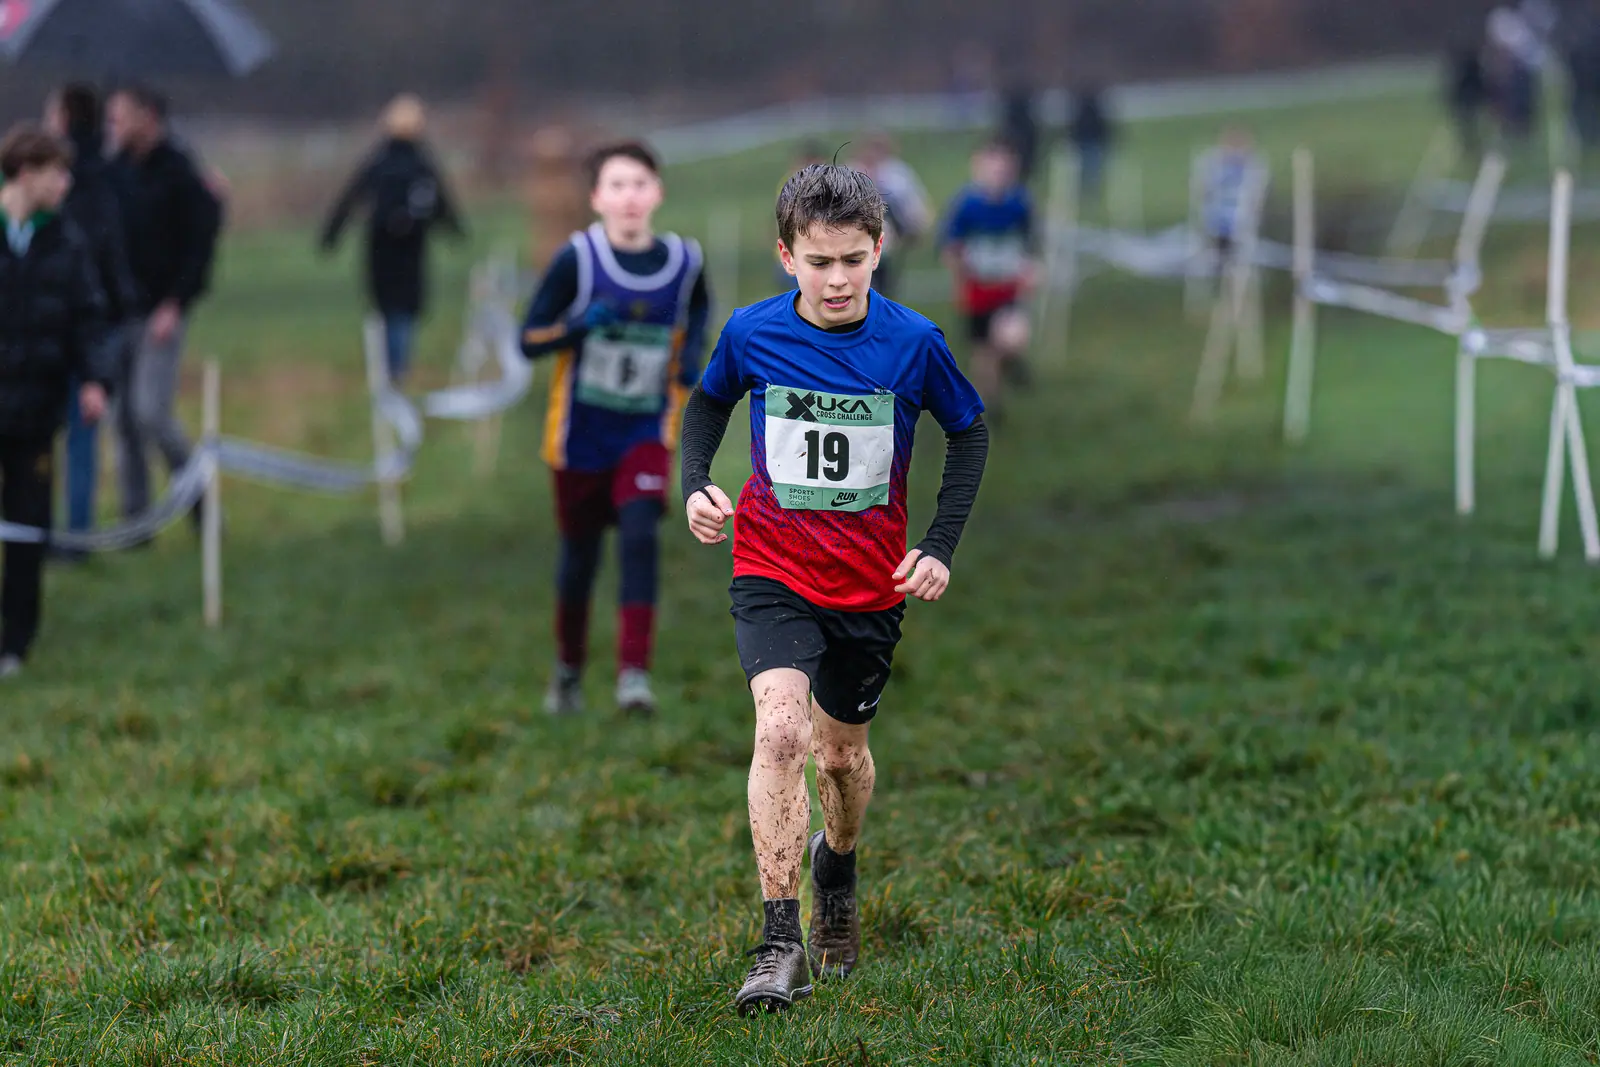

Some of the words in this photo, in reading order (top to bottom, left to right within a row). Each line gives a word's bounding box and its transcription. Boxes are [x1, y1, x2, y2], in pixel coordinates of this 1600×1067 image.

[816, 411, 836, 419] CROSS
[837, 413, 873, 421] CHALLENGE
[805, 430, 849, 482] 19
[837, 492, 858, 500] RUN
